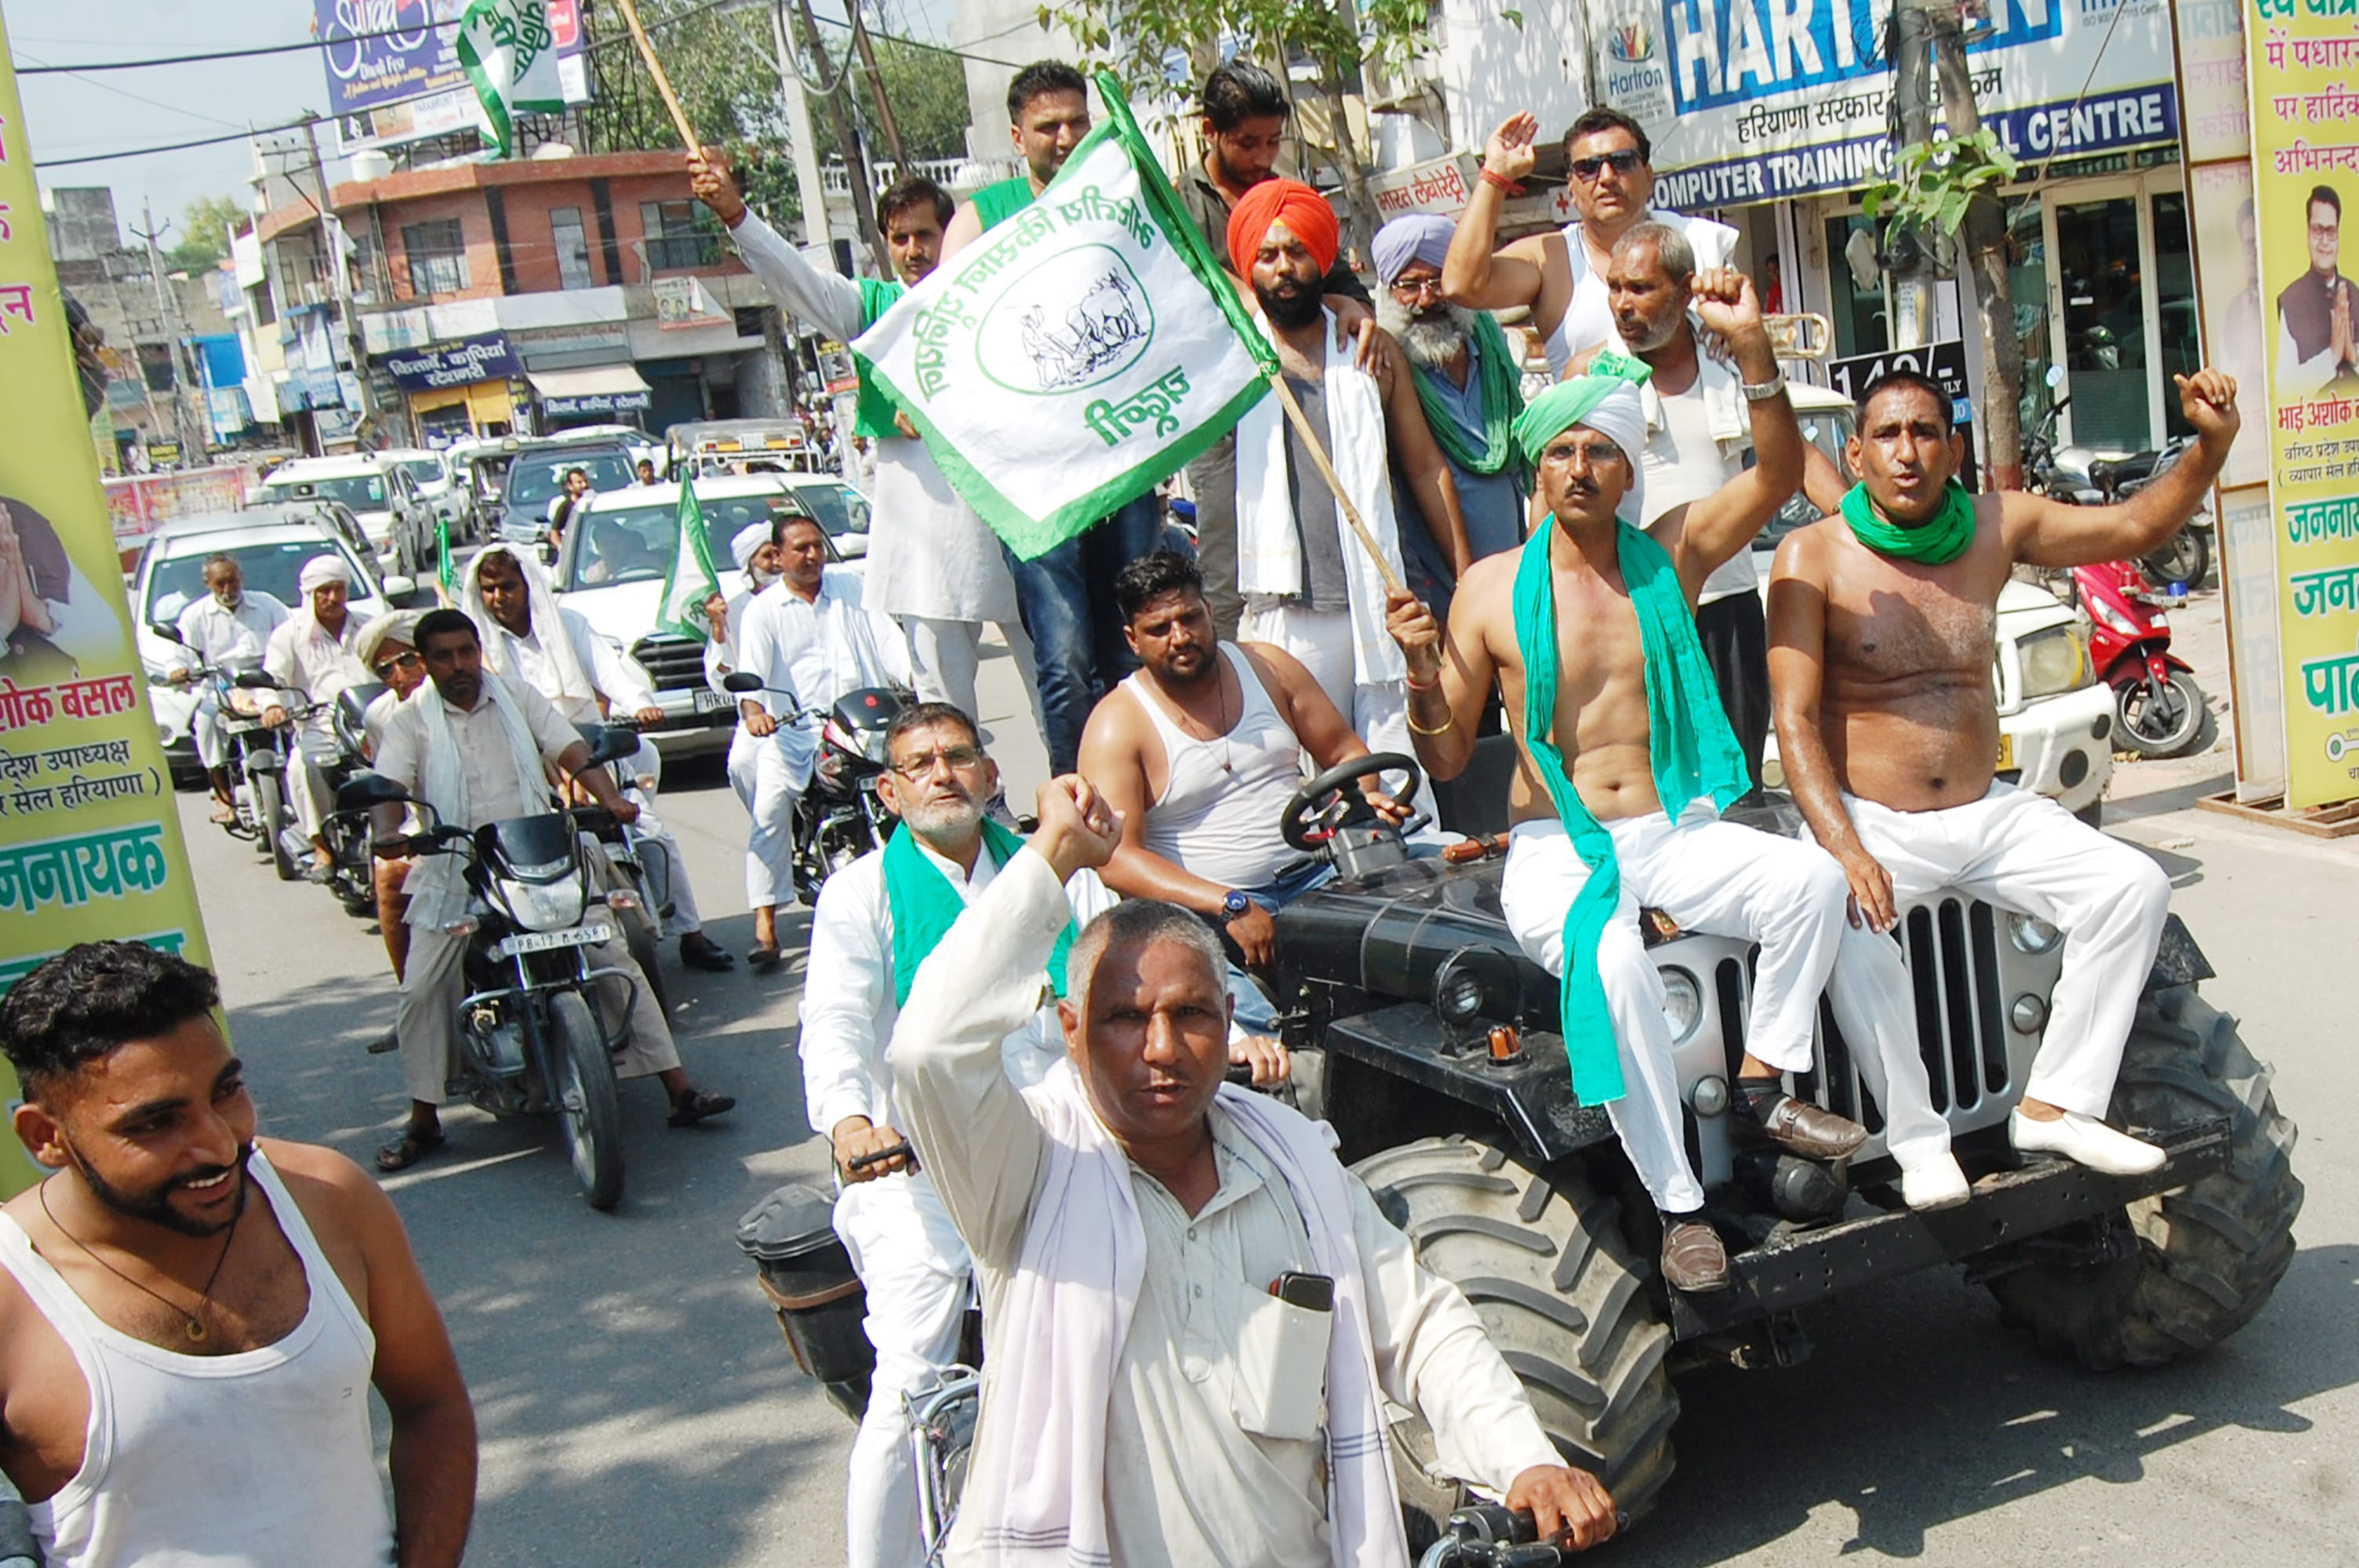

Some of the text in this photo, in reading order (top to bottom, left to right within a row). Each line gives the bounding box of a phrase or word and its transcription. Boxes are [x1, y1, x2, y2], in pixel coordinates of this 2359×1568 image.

[2265, 24, 2359, 71] में पधार
[1608, 67, 1663, 96] Hartron
[1736, 103, 1810, 143] हरियाणा
[1816, 90, 1885, 125] सरकार
[2273, 96, 2299, 122] पर
[1767, 138, 1894, 191] TRAINING
[2027, 93, 2165, 151] CENTRE
[2274, 139, 2359, 175] अभिनन्द
[1376, 185, 1414, 212] भारत
[2278, 395, 2304, 434] भाई
[2307, 391, 2352, 427] अशोक
[2284, 441, 2313, 461] वरिष्ठ
[2316, 437, 2339, 458] प्रदेश
[2289, 465, 2322, 482] व्यापार
[2326, 459, 2344, 479] सेल
[56, 671, 136, 719] बंसल
[0, 739, 129, 782] देश उपाध्यक्ष
[10, 784, 54, 815] सेल
[56, 775, 144, 808] हरियाणा
[0, 825, 166, 912] ननायक
